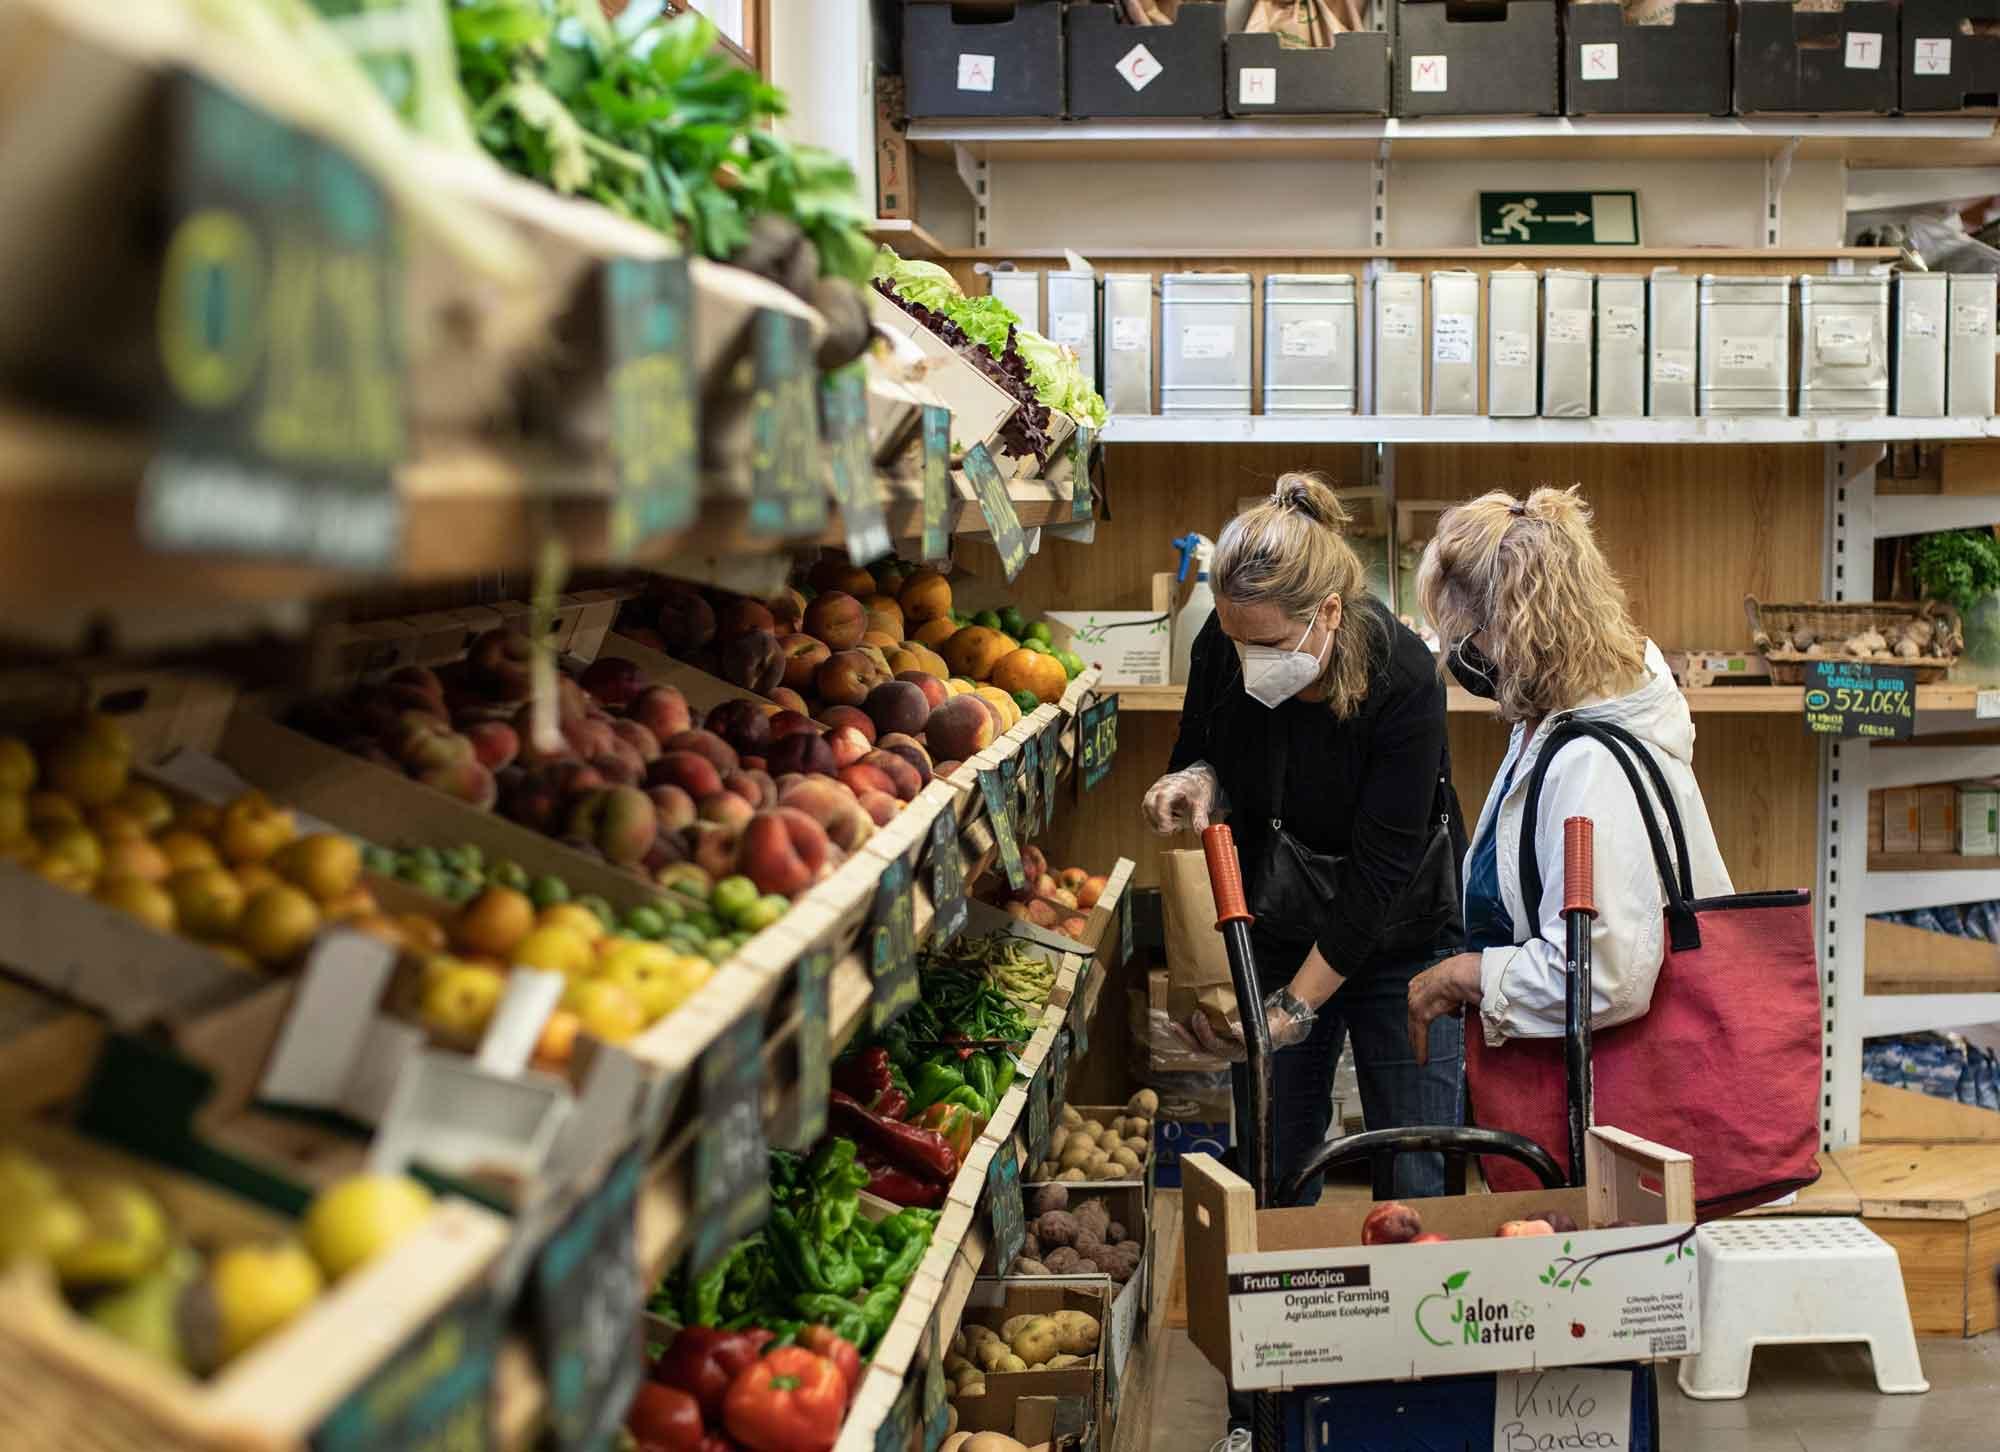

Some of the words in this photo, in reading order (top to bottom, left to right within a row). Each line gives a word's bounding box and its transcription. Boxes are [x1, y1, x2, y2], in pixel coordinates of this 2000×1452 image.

[1590, 48, 1608, 71] R
[1852, 41, 1873, 62] T
[1920, 42, 1939, 56] T
[967, 63, 988, 86] A
[1131, 57, 1146, 79] C
[1417, 61, 1440, 84] M
[1249, 75, 1265, 93] H
[1243, 1275, 1280, 1290] Fruta
[1282, 1270, 1345, 1289] Ecológica
[1284, 1290, 1335, 1309] Organic
[1336, 1288, 1390, 1303] Farming
[1284, 1309, 1337, 1322] Agriculture
[1450, 1297, 1509, 1324] Jalon
[1463, 1321, 1536, 1345] Nature
